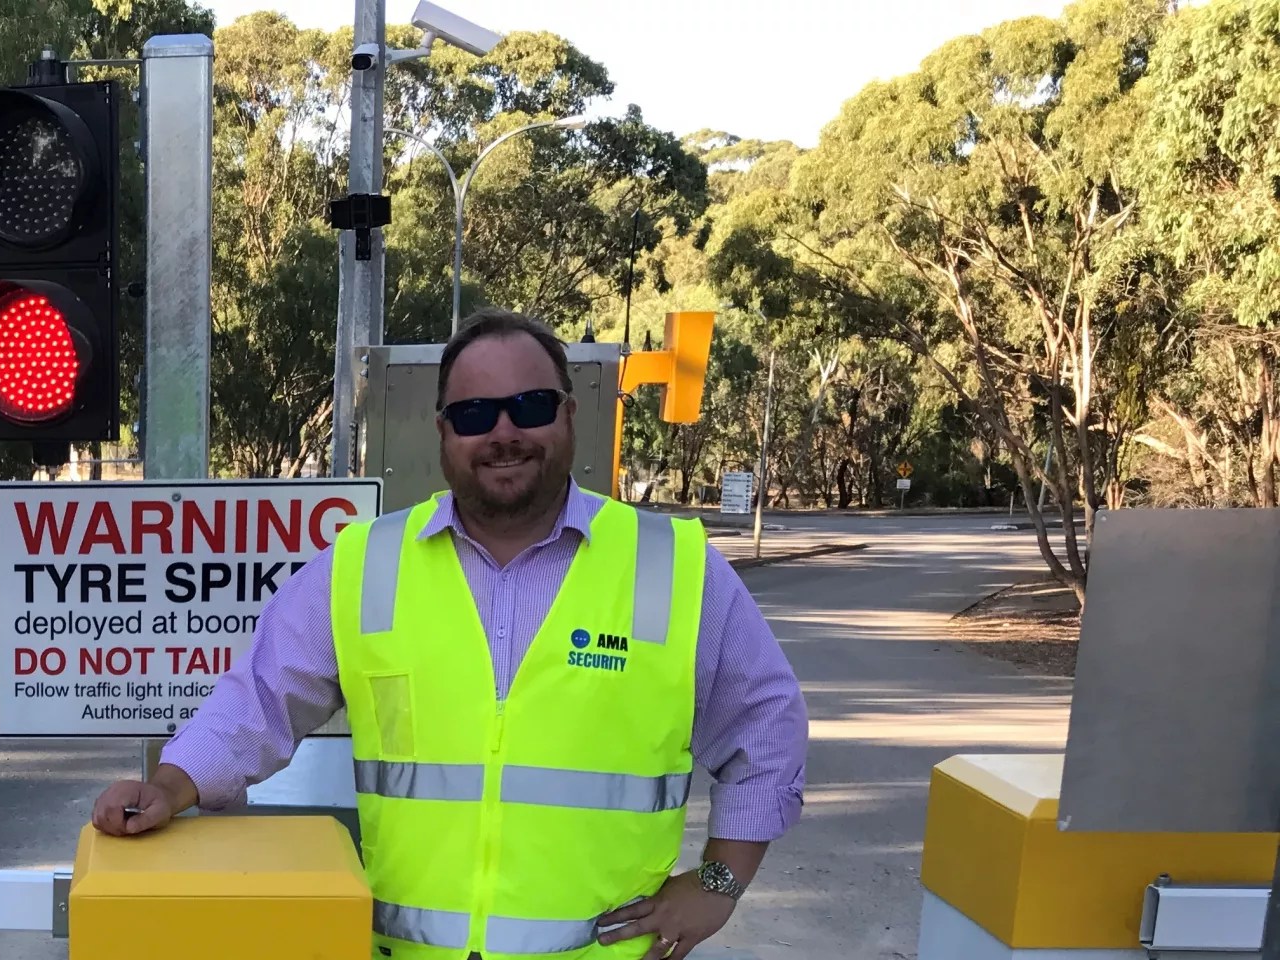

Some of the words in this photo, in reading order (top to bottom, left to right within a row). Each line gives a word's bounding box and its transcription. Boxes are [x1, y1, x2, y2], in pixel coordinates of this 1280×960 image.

[14, 497, 358, 556] WARNING
[14, 562, 147, 604] TYRE
[164, 561, 308, 604] SPIK
[14, 610, 143, 641] deployed
[151, 612, 178, 635] at
[597, 633, 628, 652] AMA
[14, 647, 67, 676] DO
[79, 646, 155, 676] NOT
[567, 650, 627, 672] SECURITY
[14, 682, 70, 698] Follow
[74, 681, 121, 698] traffic
[126, 681, 164, 702] light
[81, 703, 174, 720] Authorised
